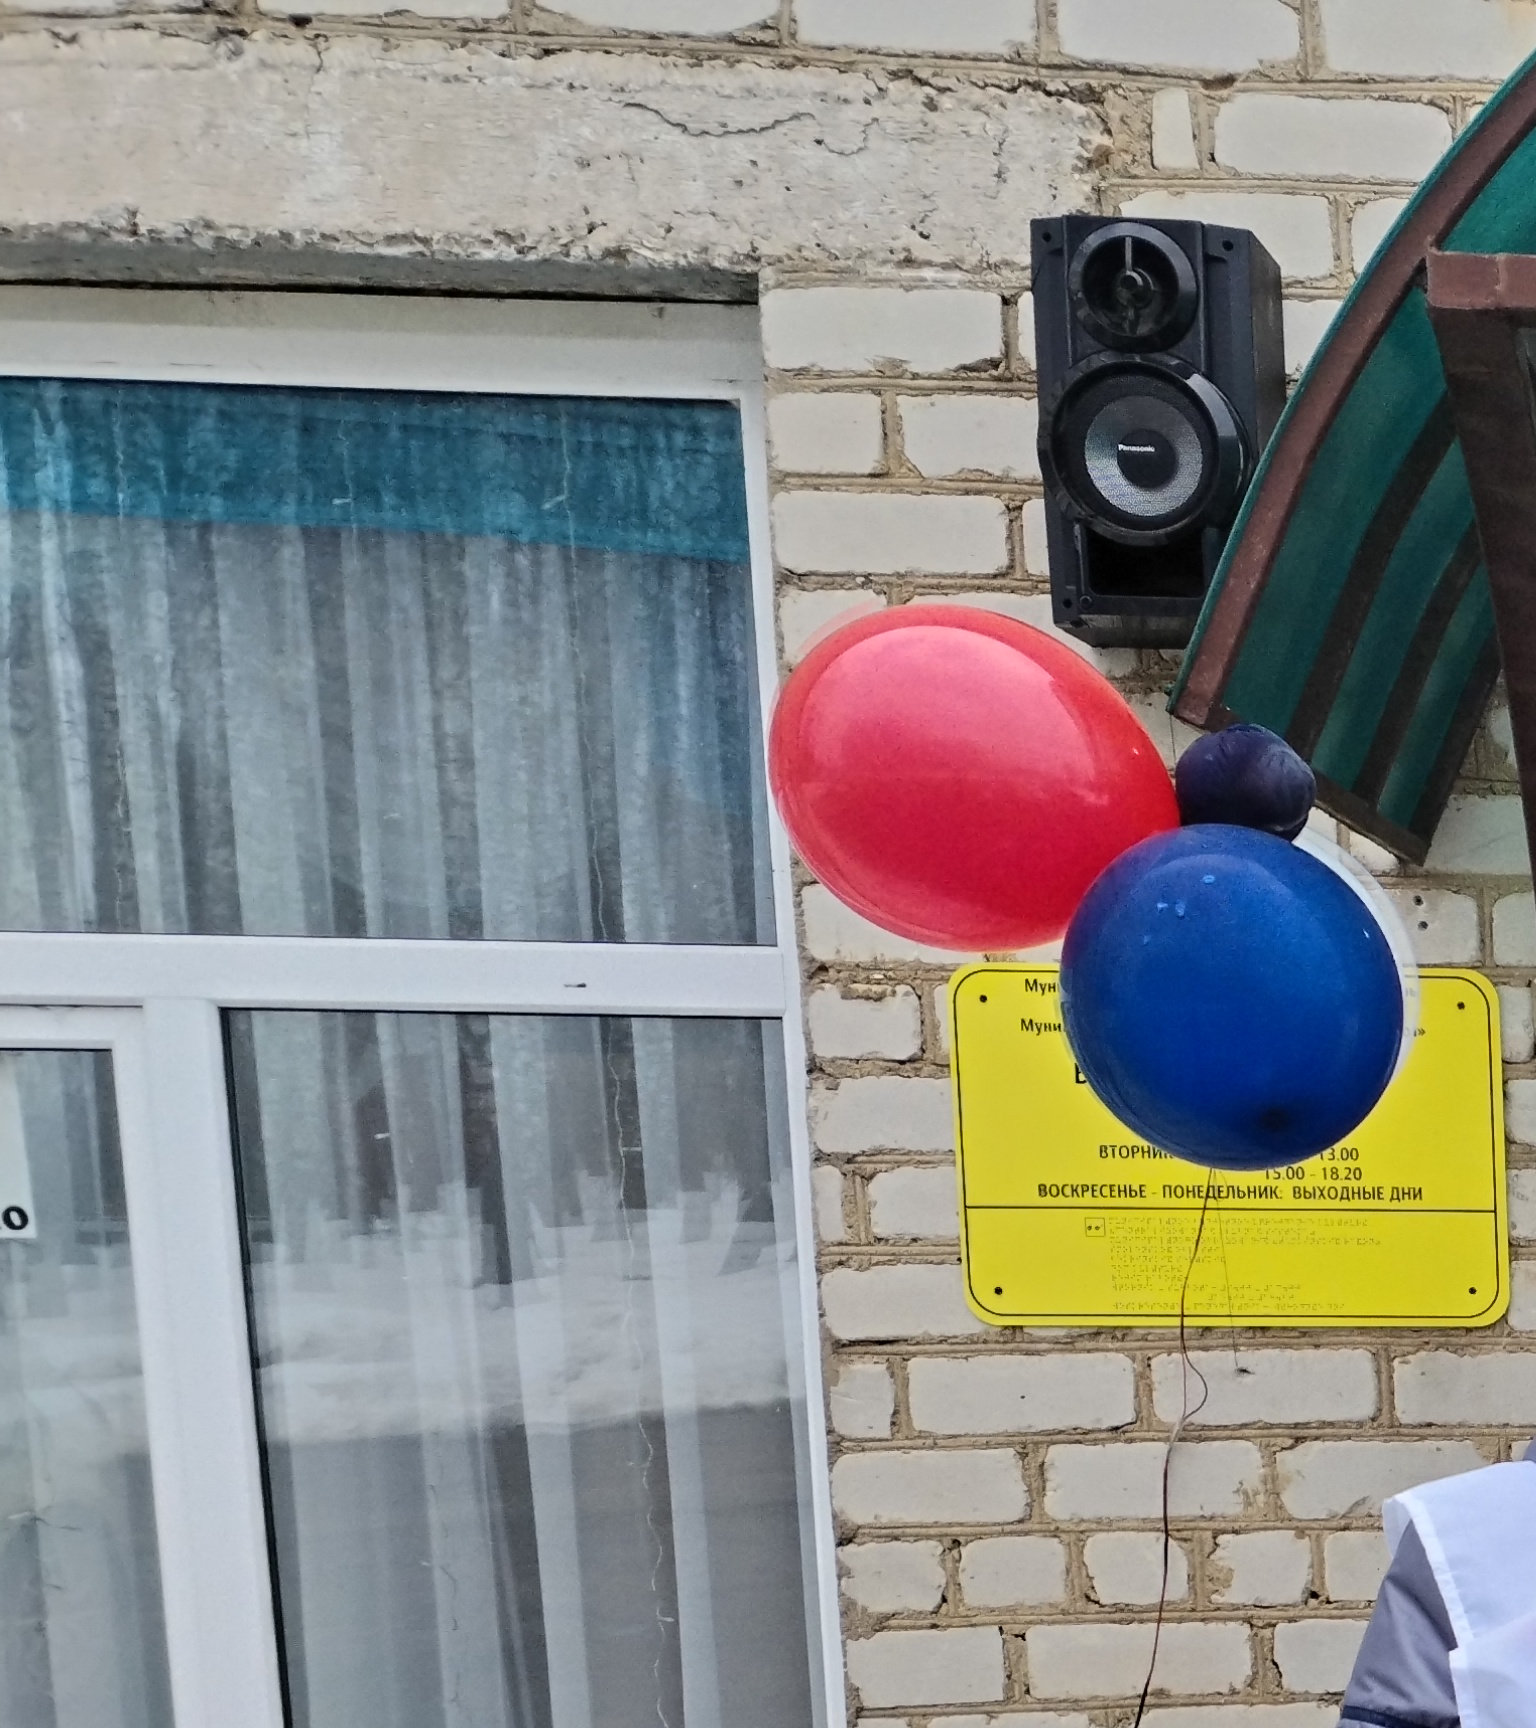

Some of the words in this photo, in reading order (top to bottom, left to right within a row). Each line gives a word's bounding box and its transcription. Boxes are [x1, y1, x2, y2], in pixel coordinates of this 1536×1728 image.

[1265, 1165, 1305, 1180] 15.00
[1321, 1166, 1363, 1181] 18.20
[1037, 1183, 1147, 1199] ВОСКРЕСЕНЬЕ
[1161, 1184, 1283, 1201] ПОНЕДЕЛЬНИК:
[1292, 1185, 1385, 1202] ВЫХОДНЫЕ
[1389, 1187, 1423, 1203] ДНИ
